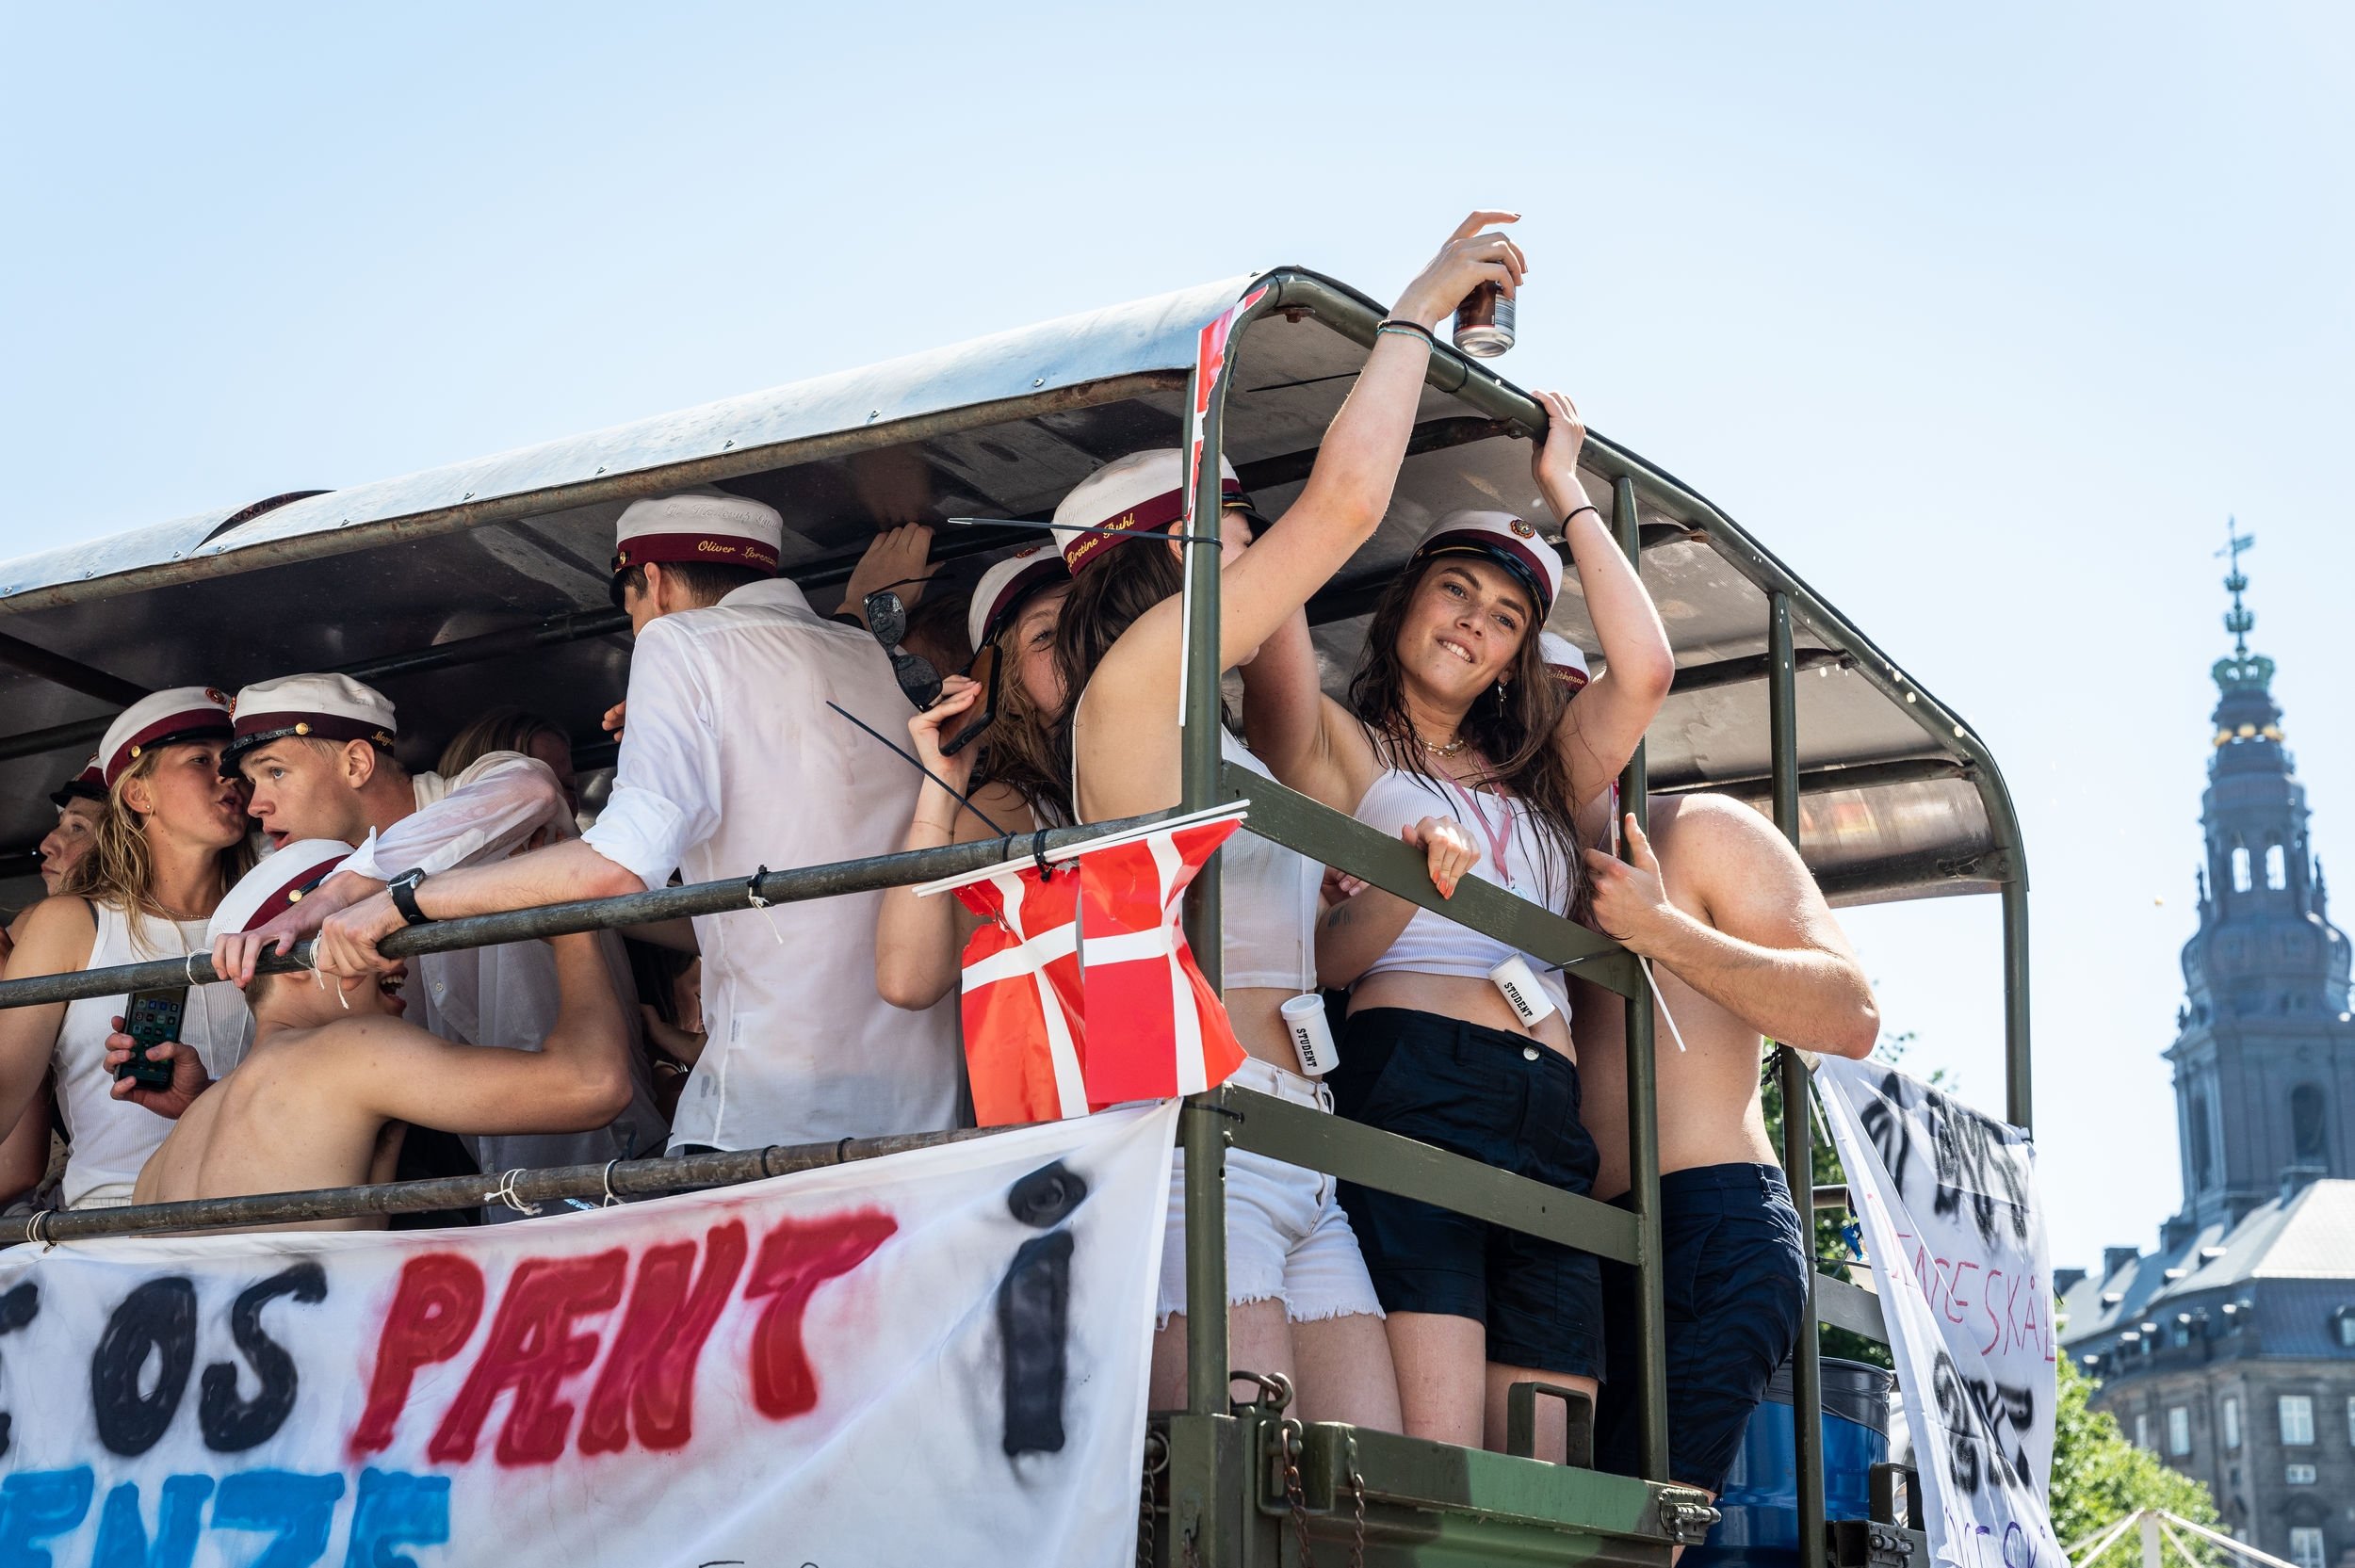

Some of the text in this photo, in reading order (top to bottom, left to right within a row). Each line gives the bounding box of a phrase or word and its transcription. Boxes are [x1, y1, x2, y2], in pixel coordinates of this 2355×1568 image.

[698, 540, 736, 554] Oliver
[1504, 981, 1533, 1018] STUDENT
[1295, 1027, 1317, 1068] STUDENT
[1980, 1269, 2056, 1362] SKÅL
[92, 1273, 327, 1458] OS
[346, 1207, 898, 1467] PÆNT
